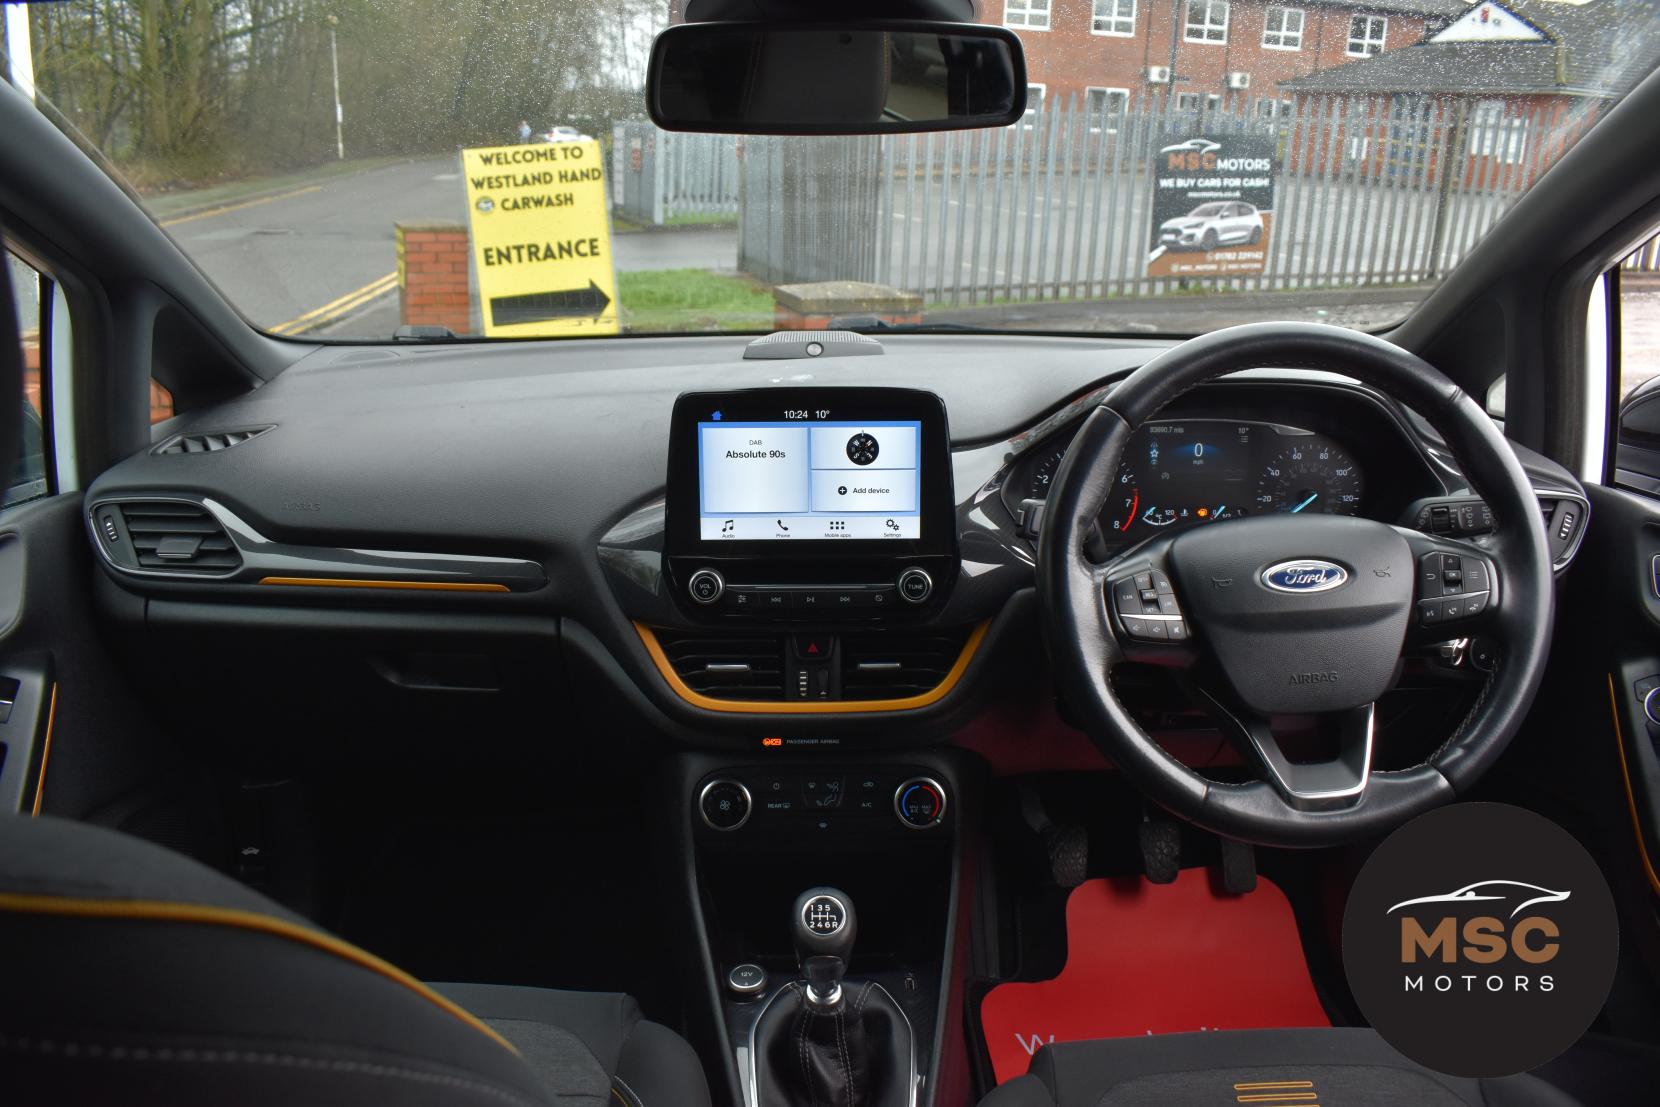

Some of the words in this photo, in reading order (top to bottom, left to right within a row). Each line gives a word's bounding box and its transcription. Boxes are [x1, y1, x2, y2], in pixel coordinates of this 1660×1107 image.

[479, 149, 557, 166] WELCOME
[561, 146, 583, 159] TO
[1168, 152, 1217, 171] MSC
[1217, 158, 1270, 171] MOTORS
[471, 171, 553, 190] WESTLAND
[559, 168, 601, 183] HAND
[1159, 178, 1174, 188] WE
[1176, 178, 1196, 188] BUY
[1197, 178, 1222, 188] CARS
[1223, 178, 1242, 188] FOR
[1242, 178, 1270, 187] CASH!
[501, 193, 574, 211] CARWASH
[483, 238, 600, 266] ENTRANCE
[784, 410, 808, 420] 10:24
[726, 450, 766, 458] Absolute
[770, 450, 786, 458] 90s
[1194, 443, 1203, 456] 0
[1042, 475, 1048, 484] 2
[1122, 475, 1128, 483] 6
[1125, 499, 1132, 507] 7
[1114, 520, 1120, 528] 8
[1285, 567, 1326, 584] Ford
[1289, 671, 1338, 686] AIRBAG
